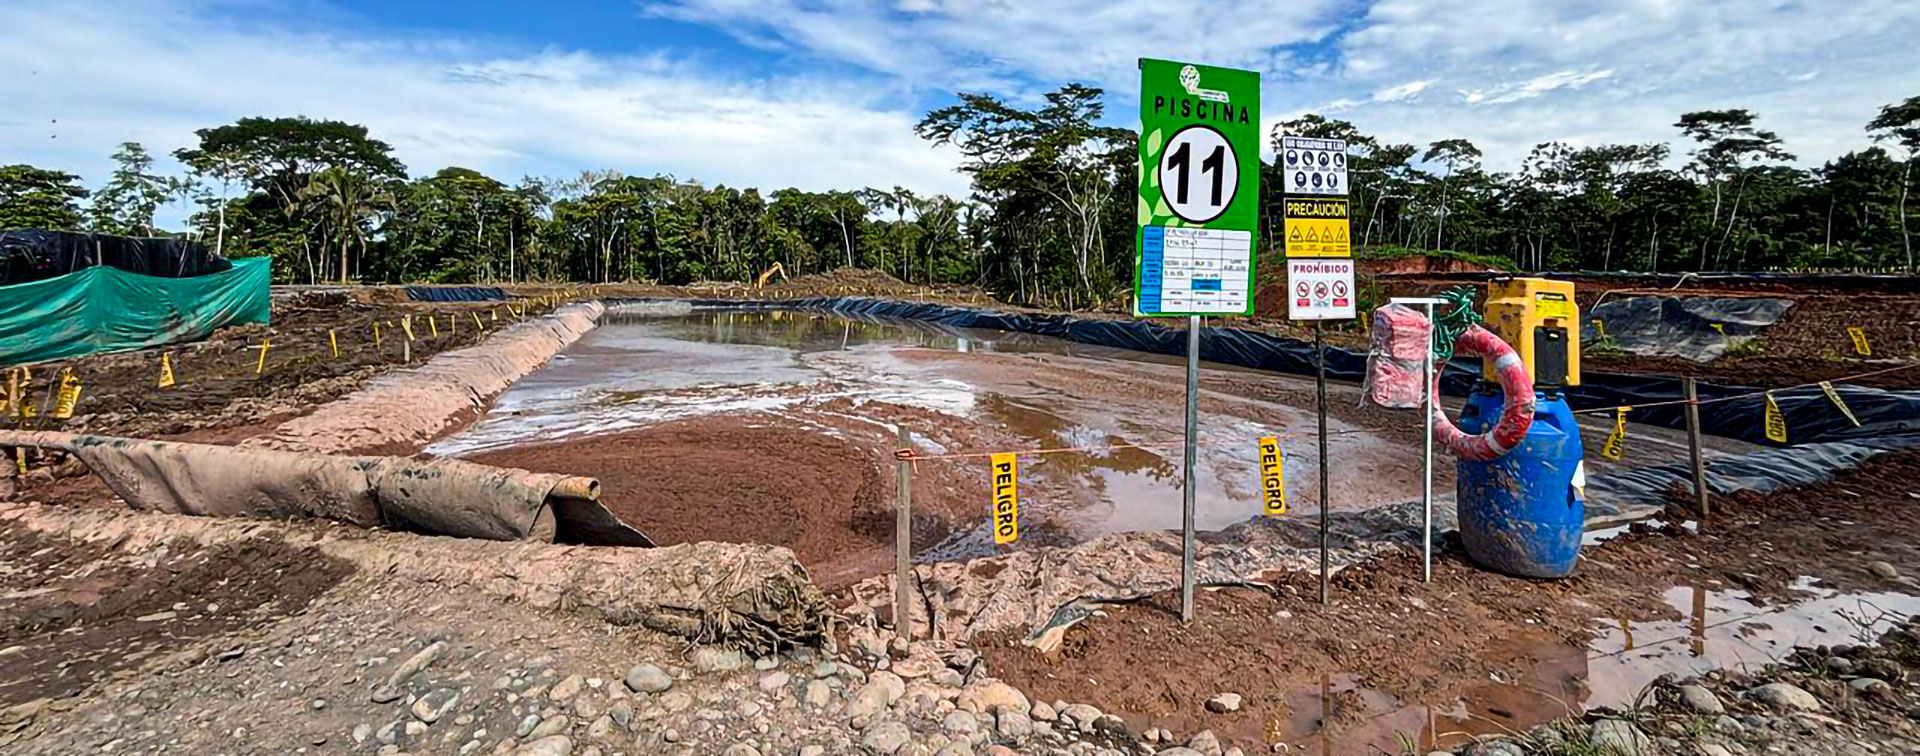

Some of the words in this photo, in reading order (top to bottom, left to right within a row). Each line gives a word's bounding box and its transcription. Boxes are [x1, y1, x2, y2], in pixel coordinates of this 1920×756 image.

[1155, 96, 1249, 124] PISCINA
[1167, 142, 1225, 207] 11
[1287, 202, 1346, 216] PRECAUCIÓN
[1293, 264, 1349, 274] PROHIBIDO
[996, 462, 1014, 537] PELIGRO
[1262, 444, 1283, 510] PELIGRO
